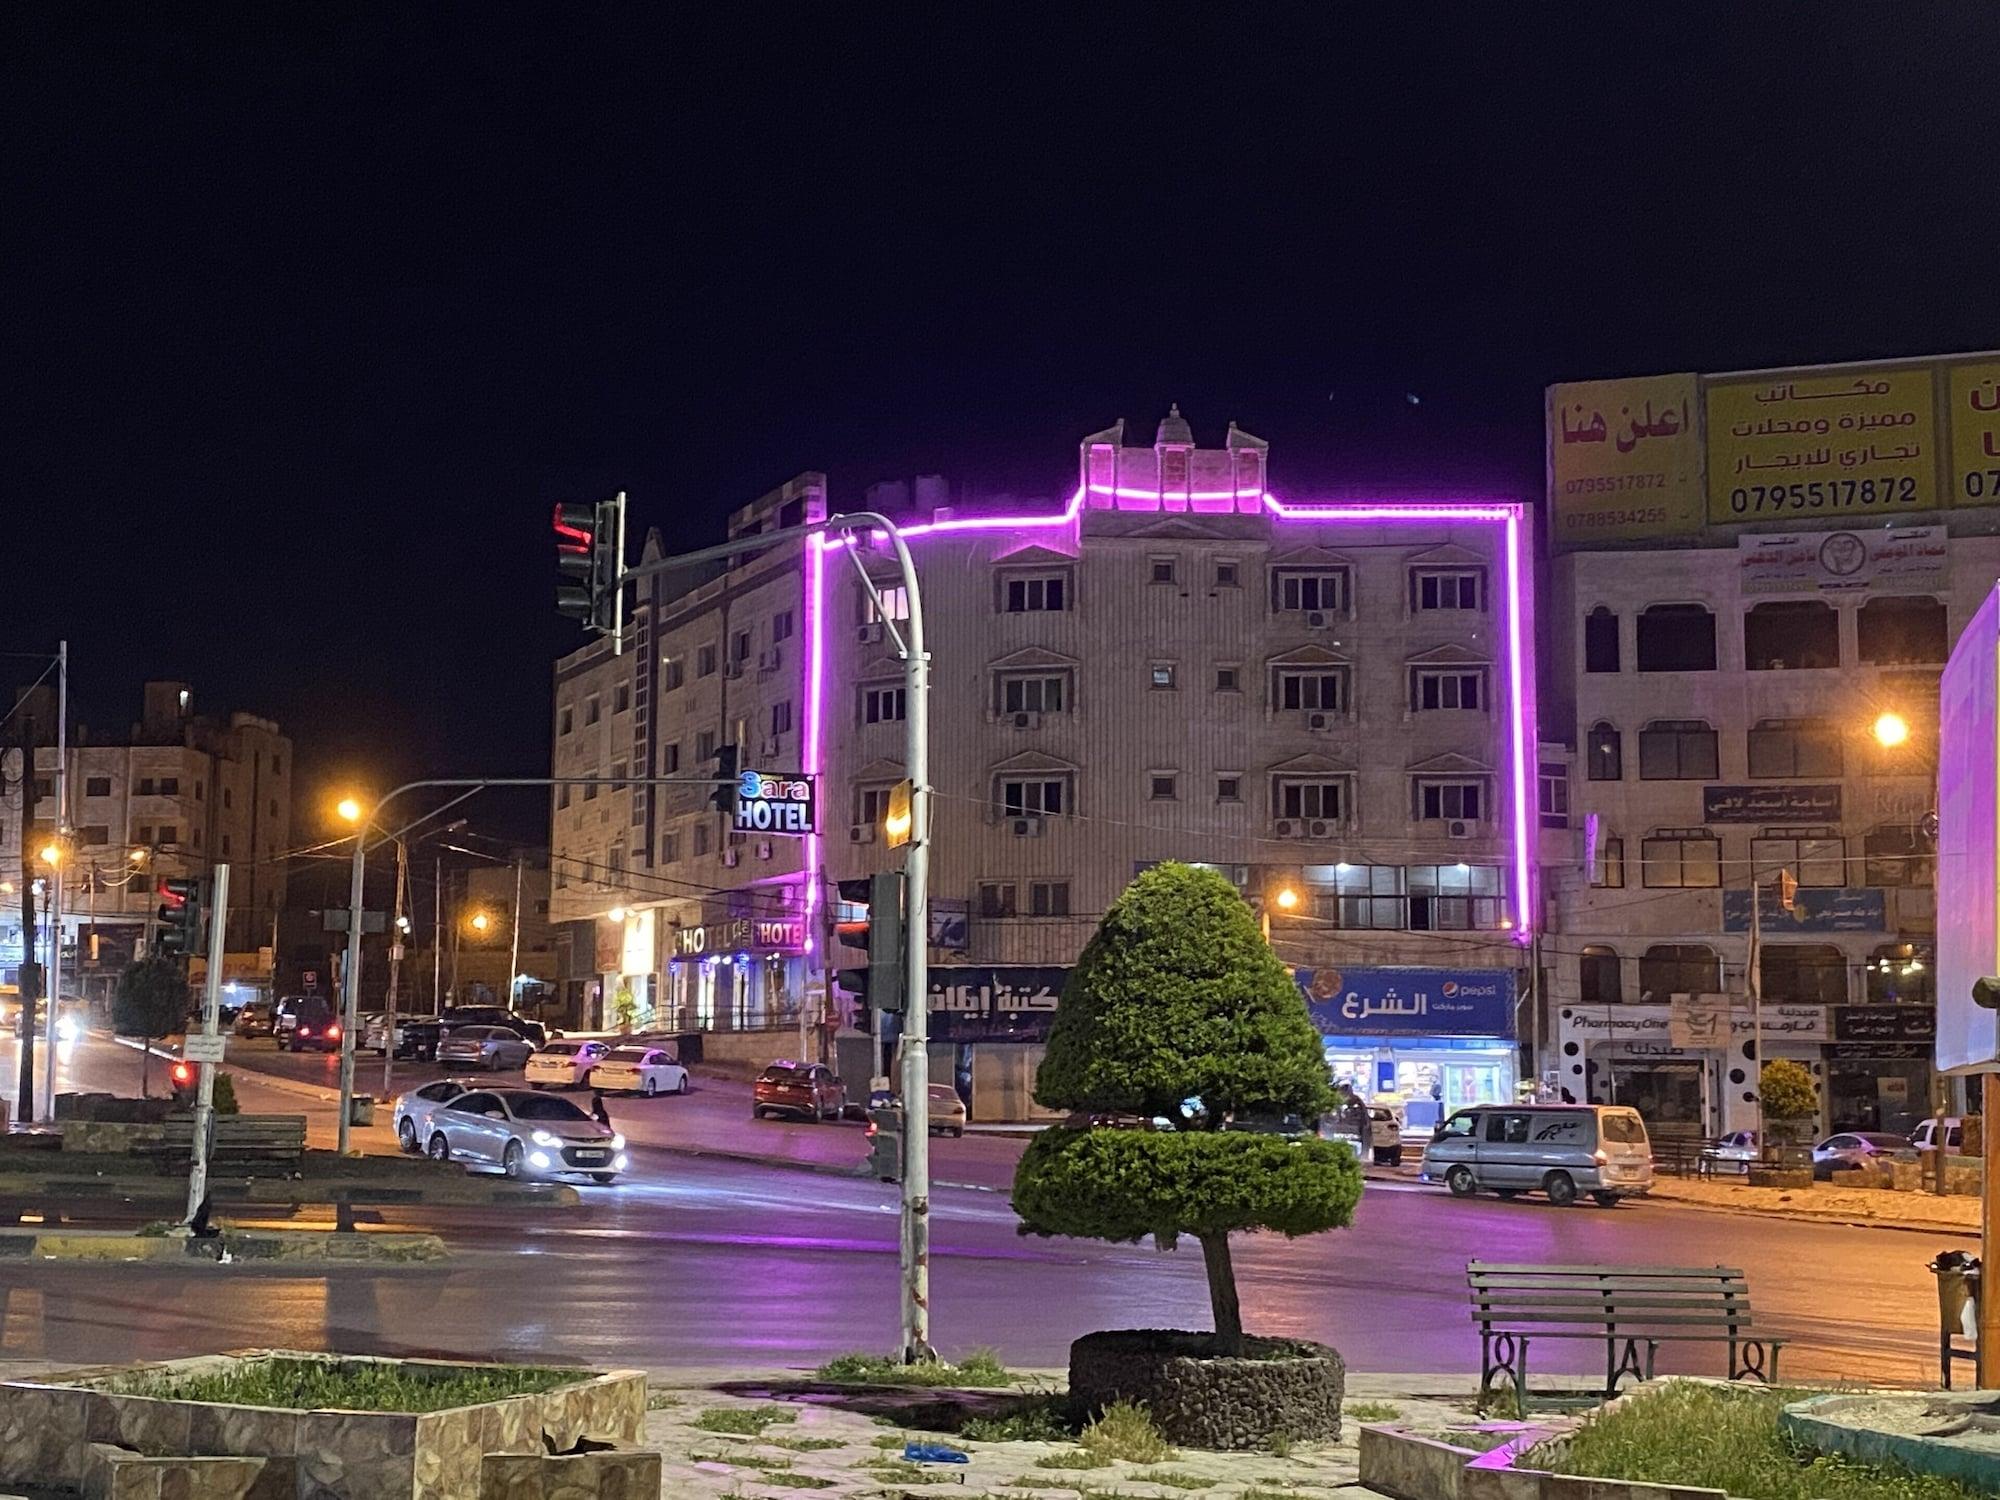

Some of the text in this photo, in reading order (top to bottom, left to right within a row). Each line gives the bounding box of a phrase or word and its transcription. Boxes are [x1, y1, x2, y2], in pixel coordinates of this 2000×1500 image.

[1755, 379, 1890, 405] مكاتب
[1561, 403, 1607, 444] هنا
[1732, 410, 1916, 437] مميزة ومحلات
[1839, 441, 1920, 469] تجاري
[1566, 473, 1665, 494] 0795517872
[1732, 476, 1917, 513] 0795517872
[738, 770, 810, 800] Sara
[737, 800, 812, 830] HOTEL
[996, 984, 1060, 1020] كتبة
[1341, 988, 1427, 1018] الشرع
[1460, 984, 1496, 997] pepsi
[1572, 1016, 1668, 1035] Pharmacy One
[1778, 1006, 1819, 1018] صيدلية
